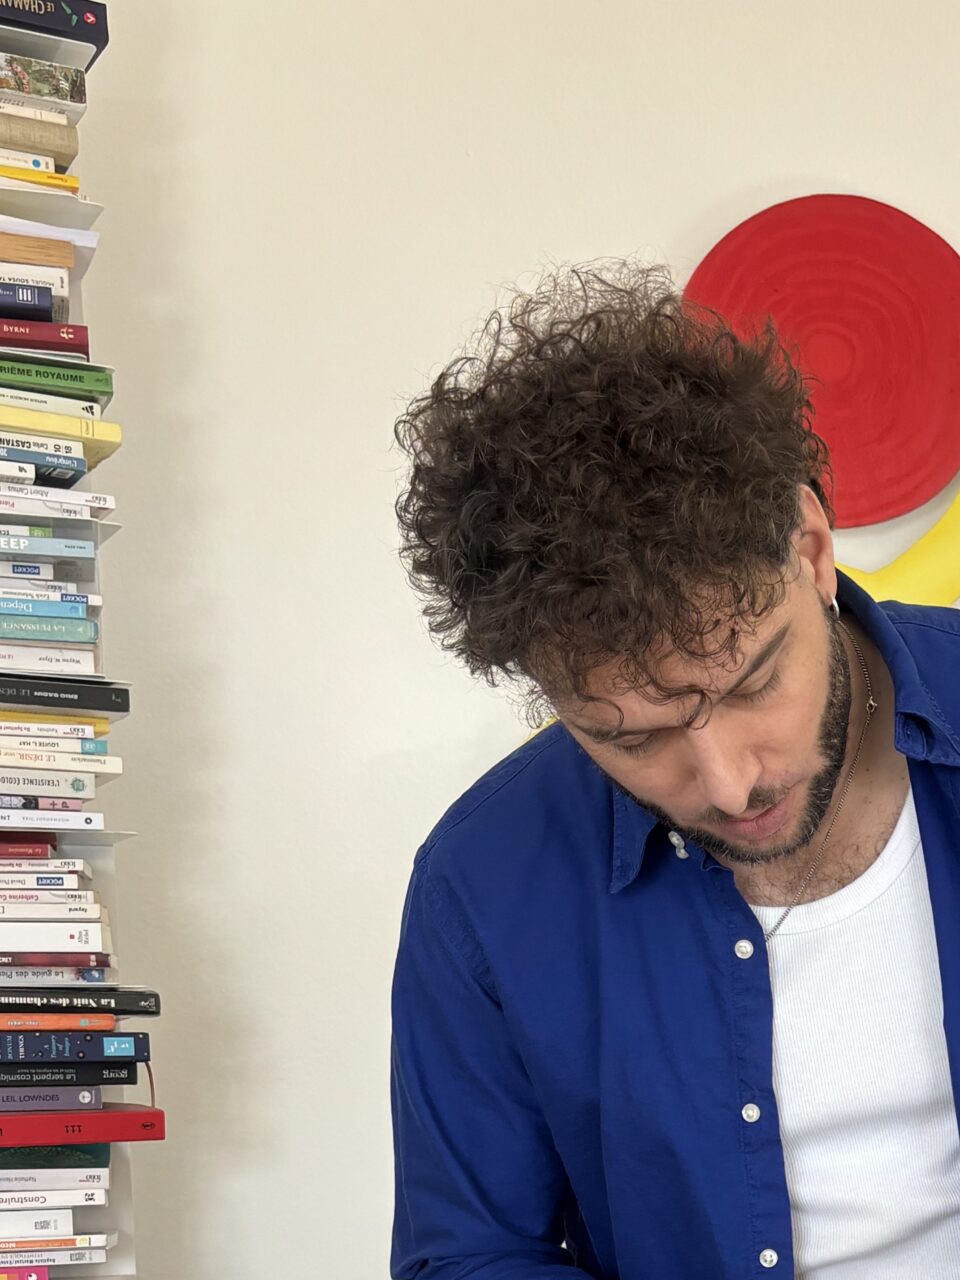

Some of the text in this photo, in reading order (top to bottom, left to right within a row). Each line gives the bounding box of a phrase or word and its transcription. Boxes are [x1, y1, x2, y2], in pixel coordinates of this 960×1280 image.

[46, 2, 54, 12] LE
[35, 370, 85, 384] ROYAUME
[8, 485, 49, 498] Albert Camus
[22, 777, 60, 787] L'EXISTENCE
[29, 969, 53, 978] guide
[0, 996, 116, 1007] La Nuit des chaman
[32, 1072, 65, 1082] serpent
[66, 1073, 76, 1081] Le
[103, 1068, 128, 1078] georg
[1, 1093, 60, 1103] LEIL LOWNDES
[64, 1124, 83, 1134] 111
